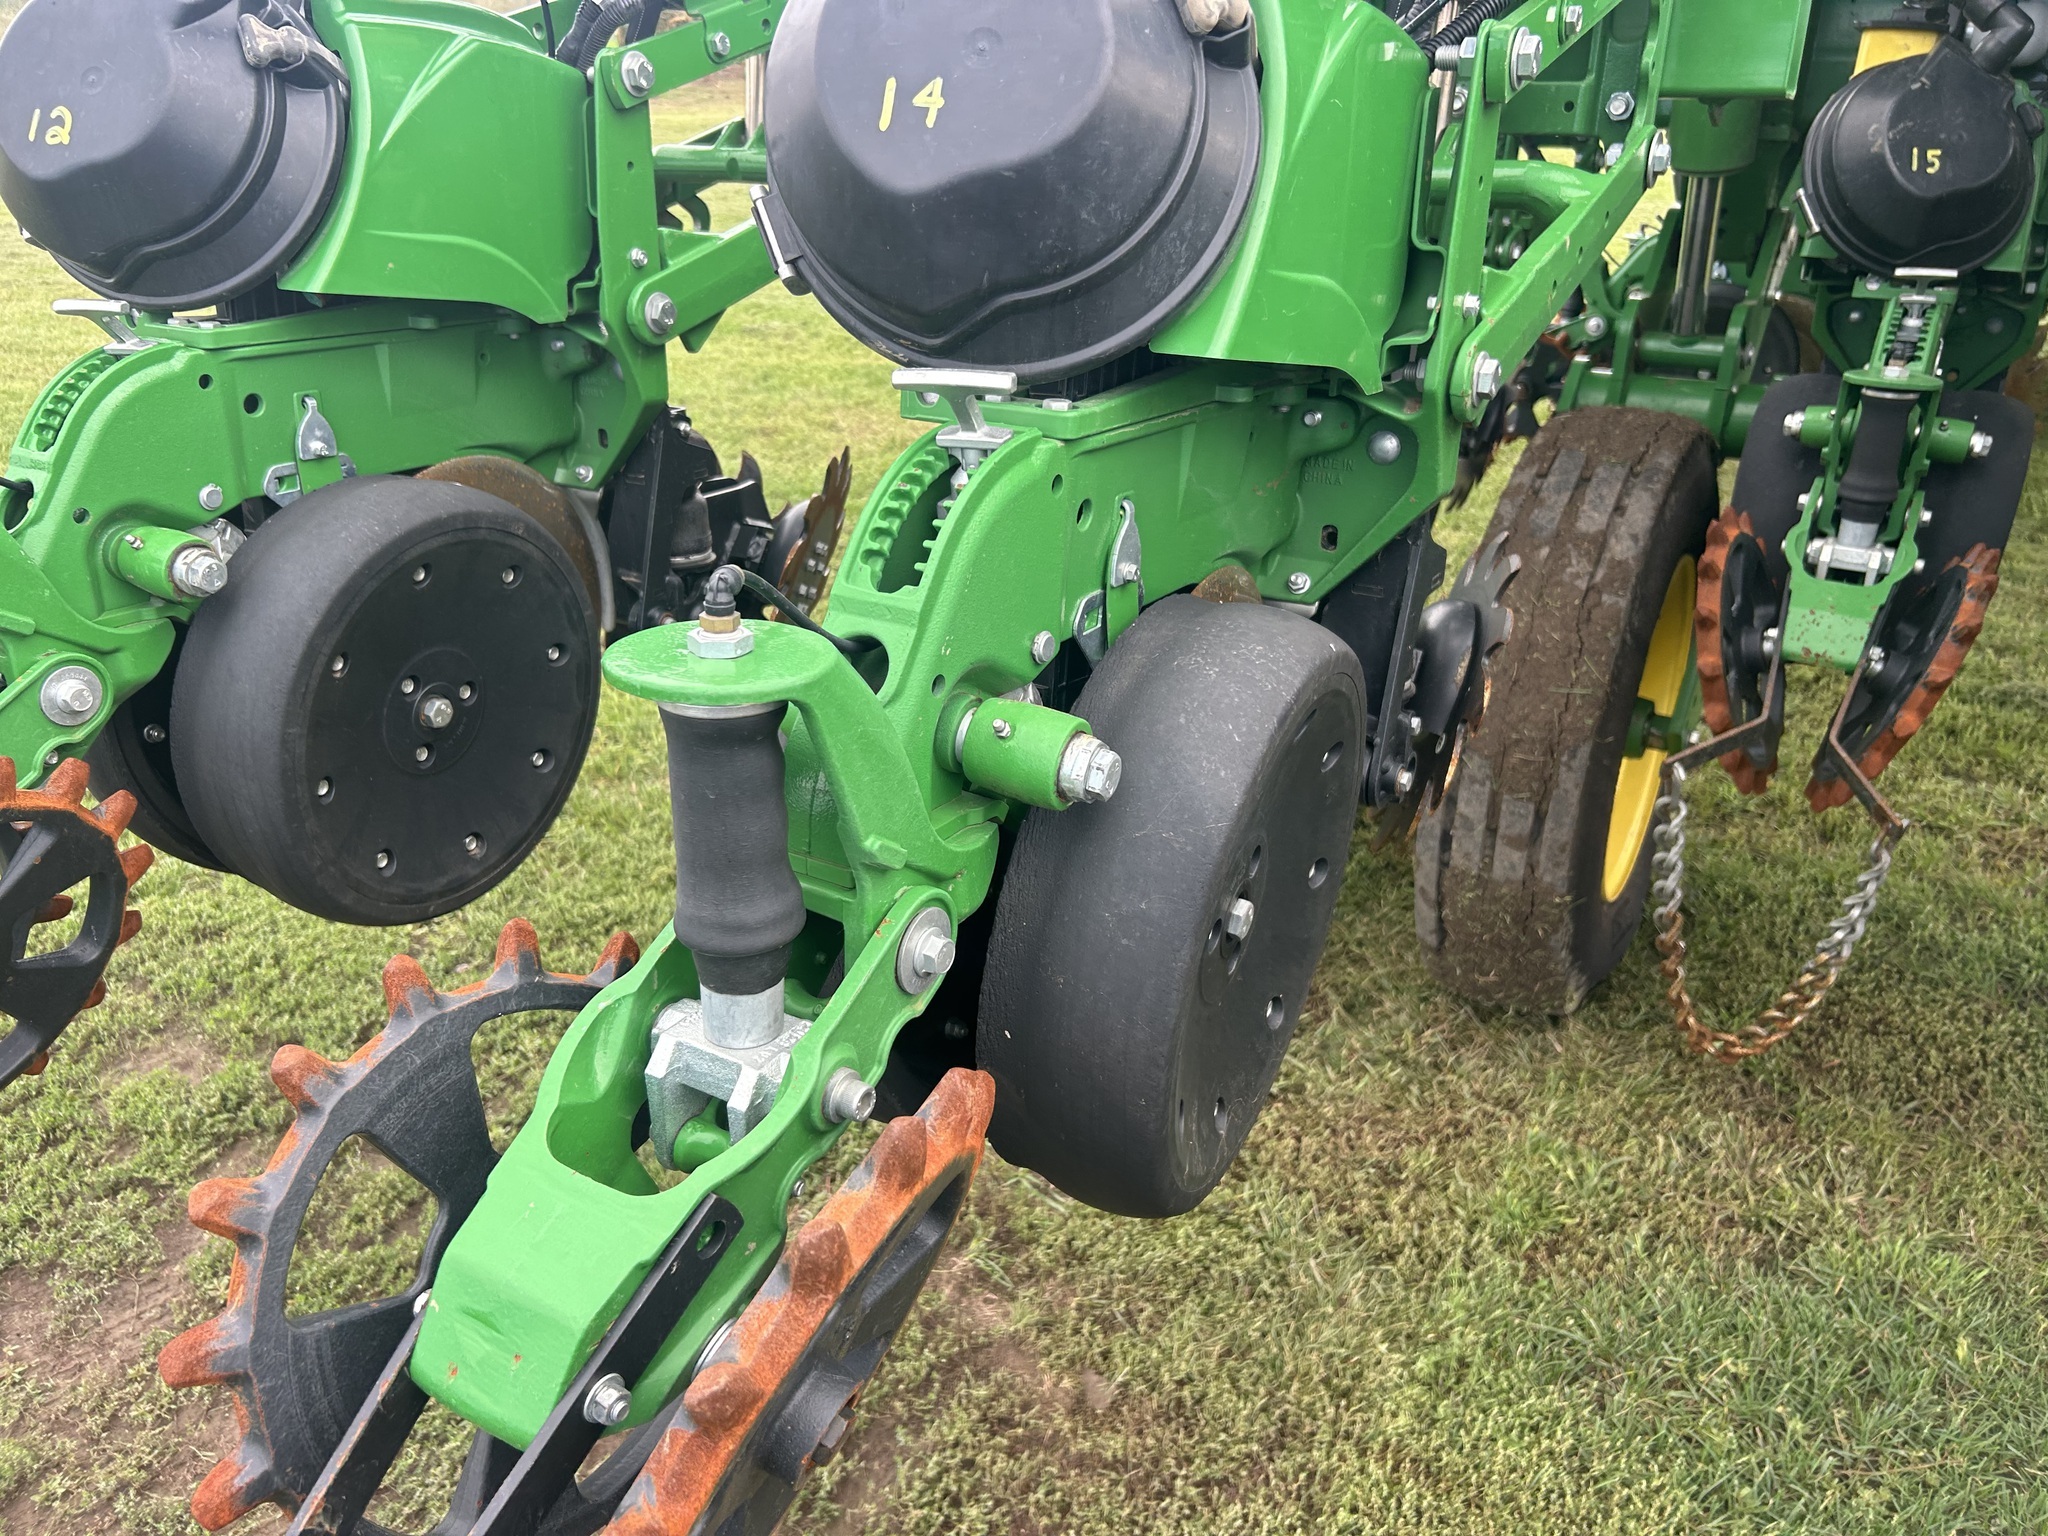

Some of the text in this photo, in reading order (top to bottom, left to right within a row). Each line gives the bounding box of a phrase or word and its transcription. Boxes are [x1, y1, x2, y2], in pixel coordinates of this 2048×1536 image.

[879, 76, 945, 132] 14
[28, 105, 72, 145] 12
[1911, 146, 1942, 174] 15
[1303, 471, 1343, 485] CHINA
[1304, 456, 1354, 472] MADE IN
